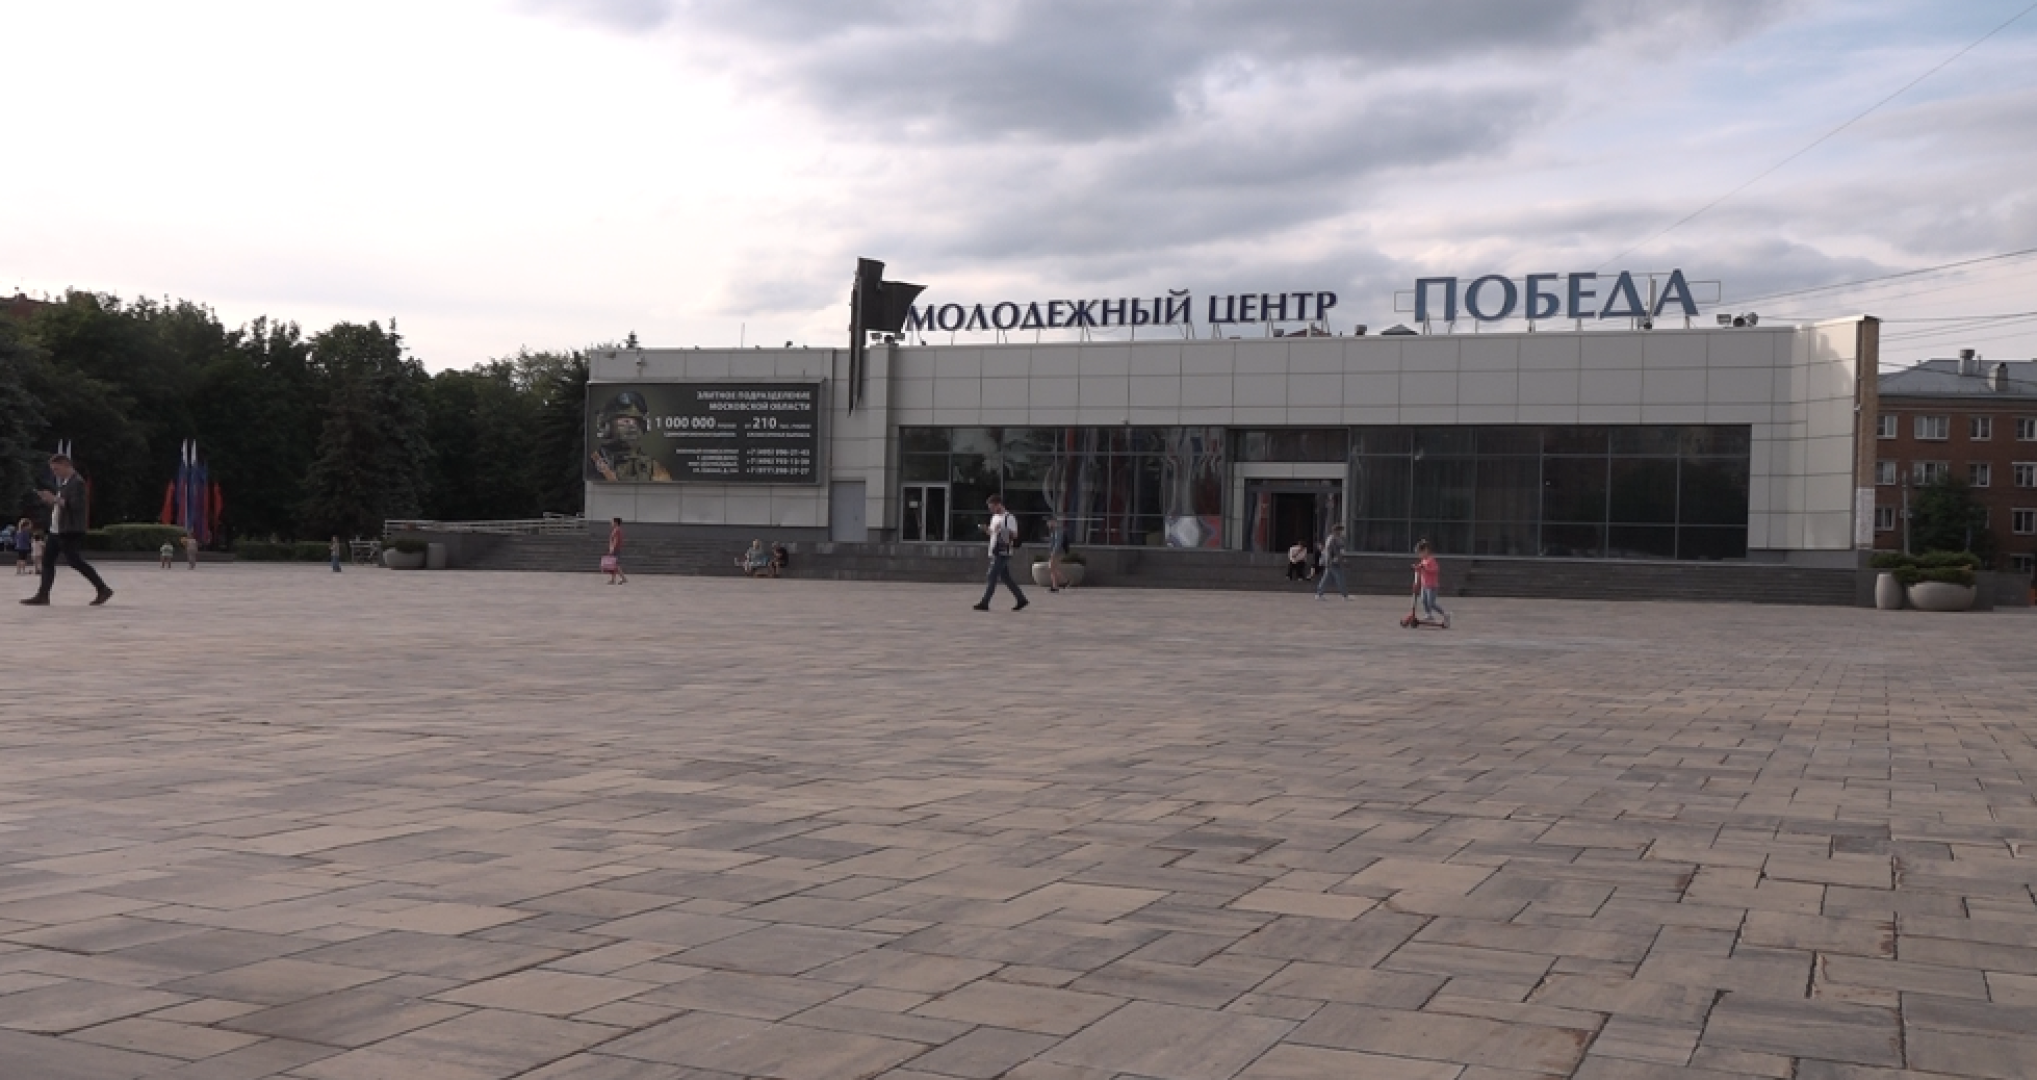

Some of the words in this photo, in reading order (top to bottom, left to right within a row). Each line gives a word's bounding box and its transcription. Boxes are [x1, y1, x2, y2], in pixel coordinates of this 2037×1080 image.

[1414, 268, 1700, 323] ПОБЕДА
[906, 288, 1191, 331] МОЛОДЕЖНЫЙ
[1208, 291, 1338, 325] ЦЕНТР
[738, 390, 811, 400] ПОДРАЗДЕЛЕНИЕ
[709, 402, 768, 411] МОСКОВСКОЙ
[769, 402, 811, 411] ОБЛАСТИ
[655, 417, 662, 429] 1
[665, 416, 690, 429] 000
[692, 416, 716, 429] 000
[752, 417, 777, 430] 210
